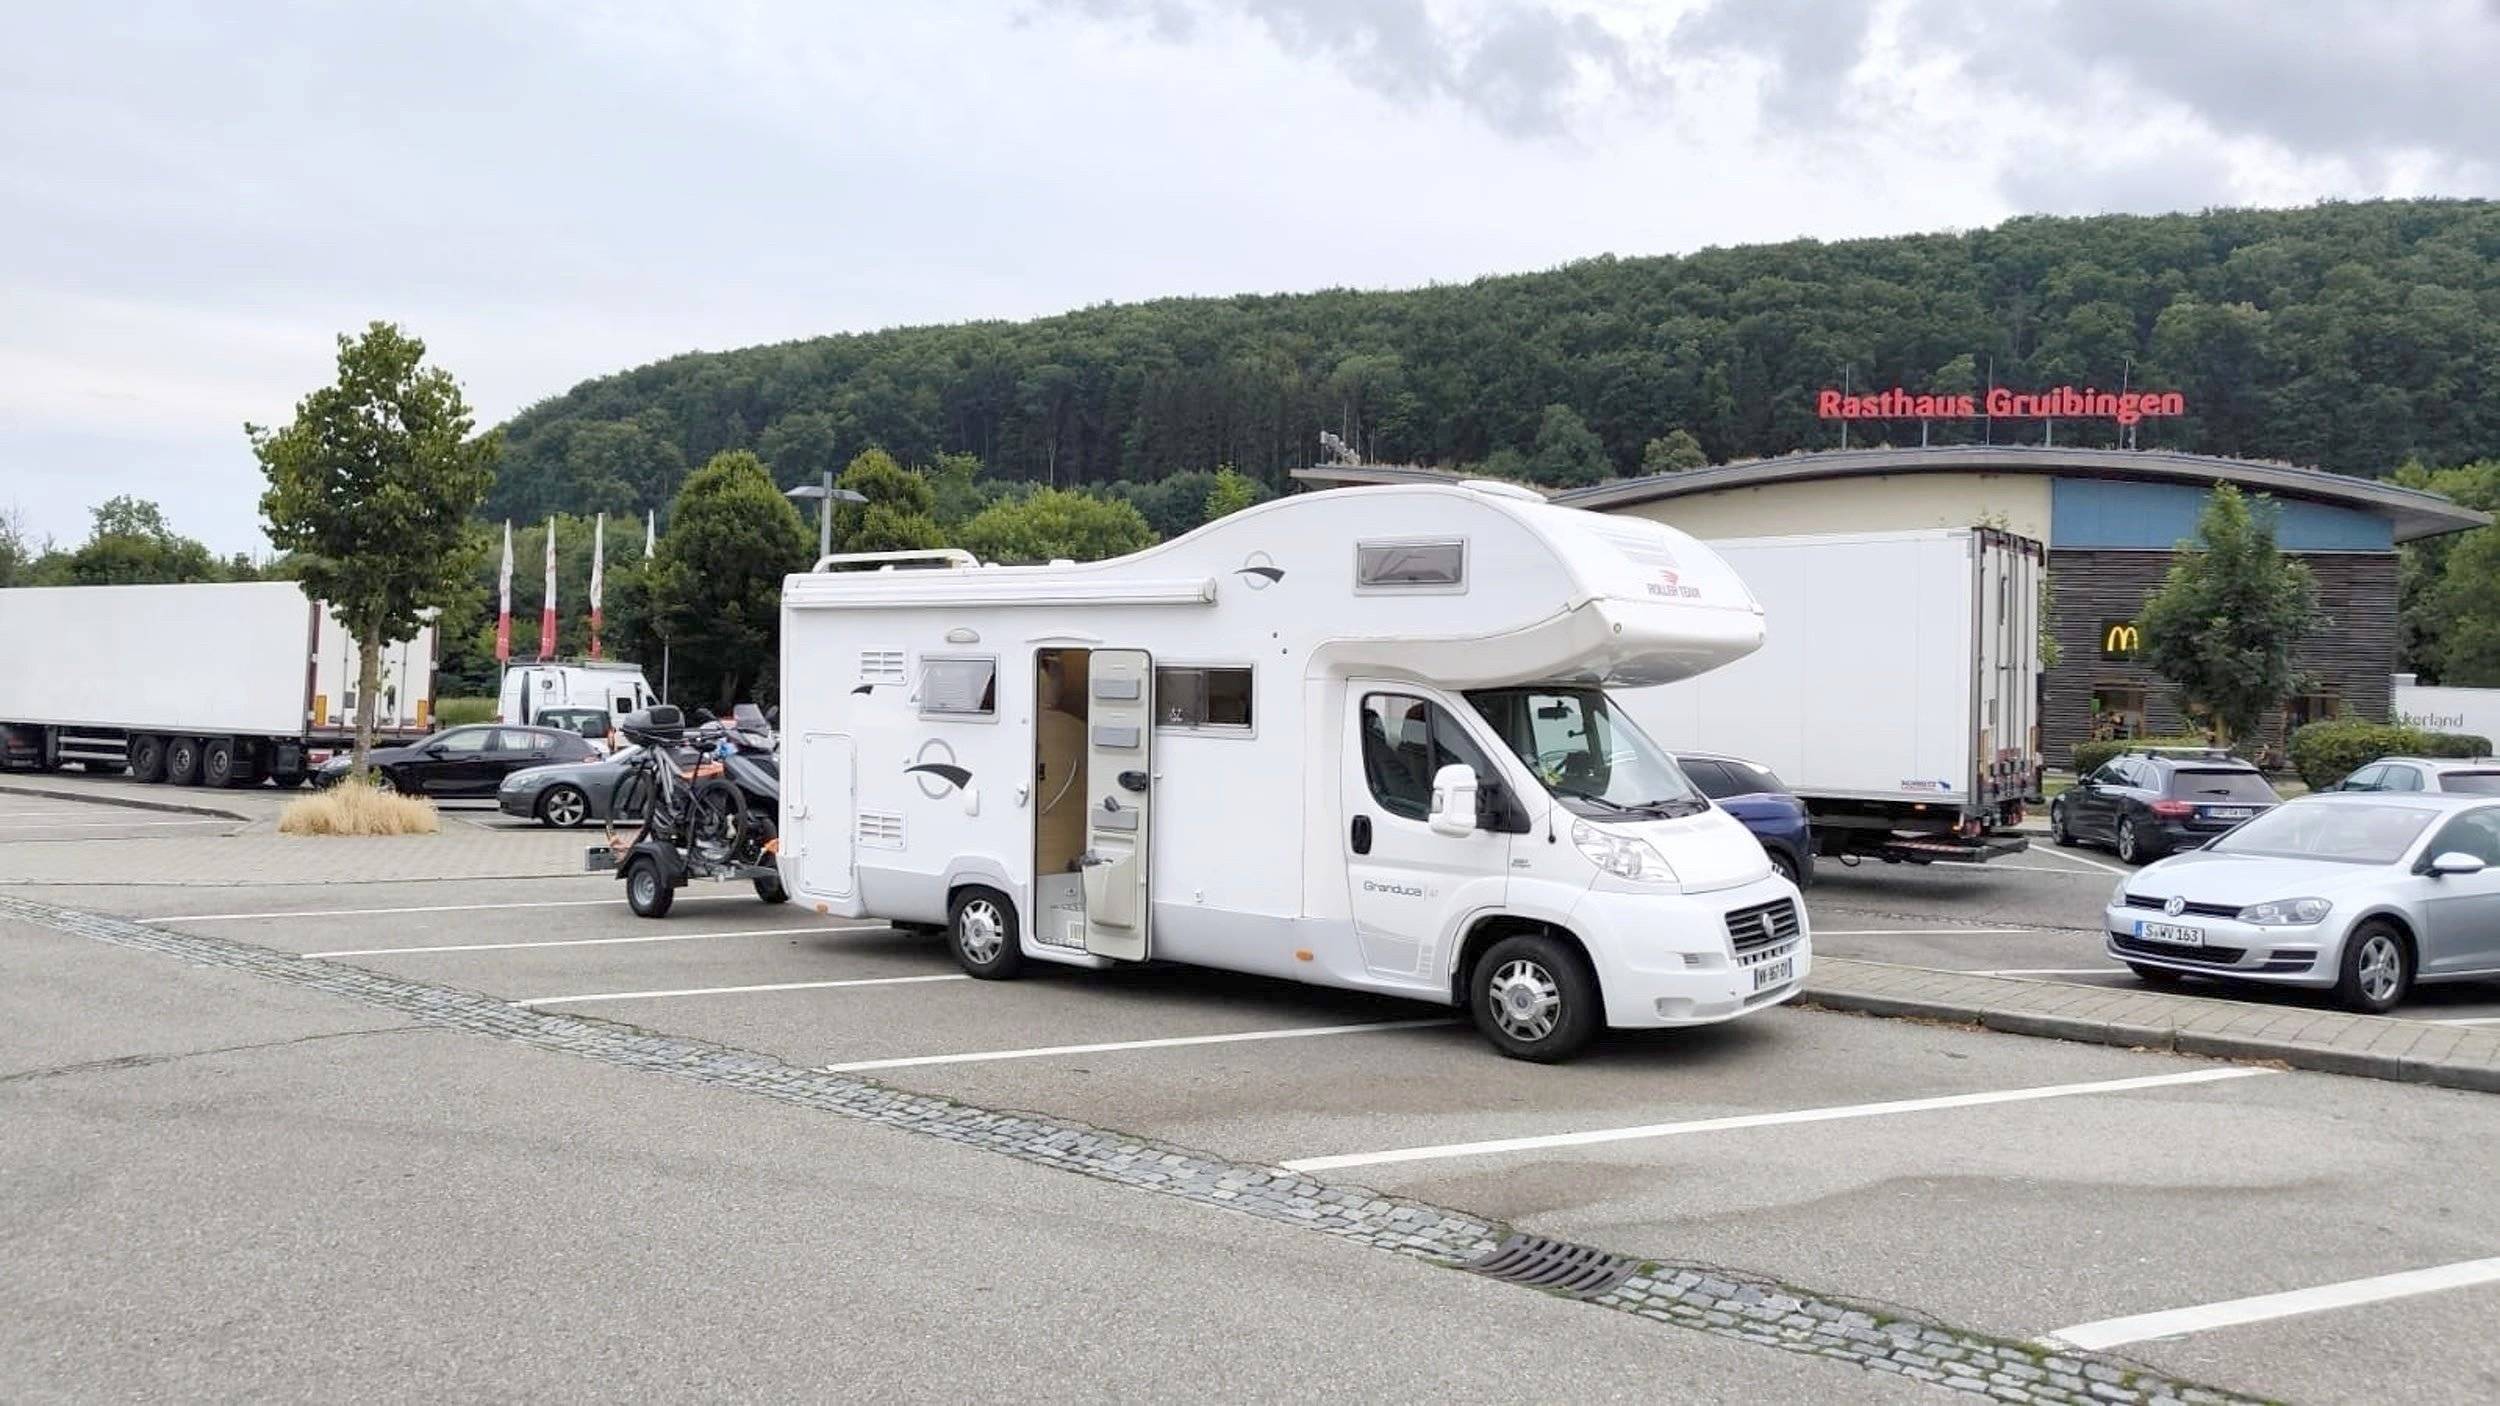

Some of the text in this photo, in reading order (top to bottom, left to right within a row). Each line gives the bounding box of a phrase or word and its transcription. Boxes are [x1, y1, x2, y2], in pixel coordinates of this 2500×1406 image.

[1819, 386, 2184, 425] Rasthaus Gruibingen
[2399, 711, 2463, 728] kerland
[1362, 880, 1423, 898] Granduca
[2176, 927, 2199, 942] 163
